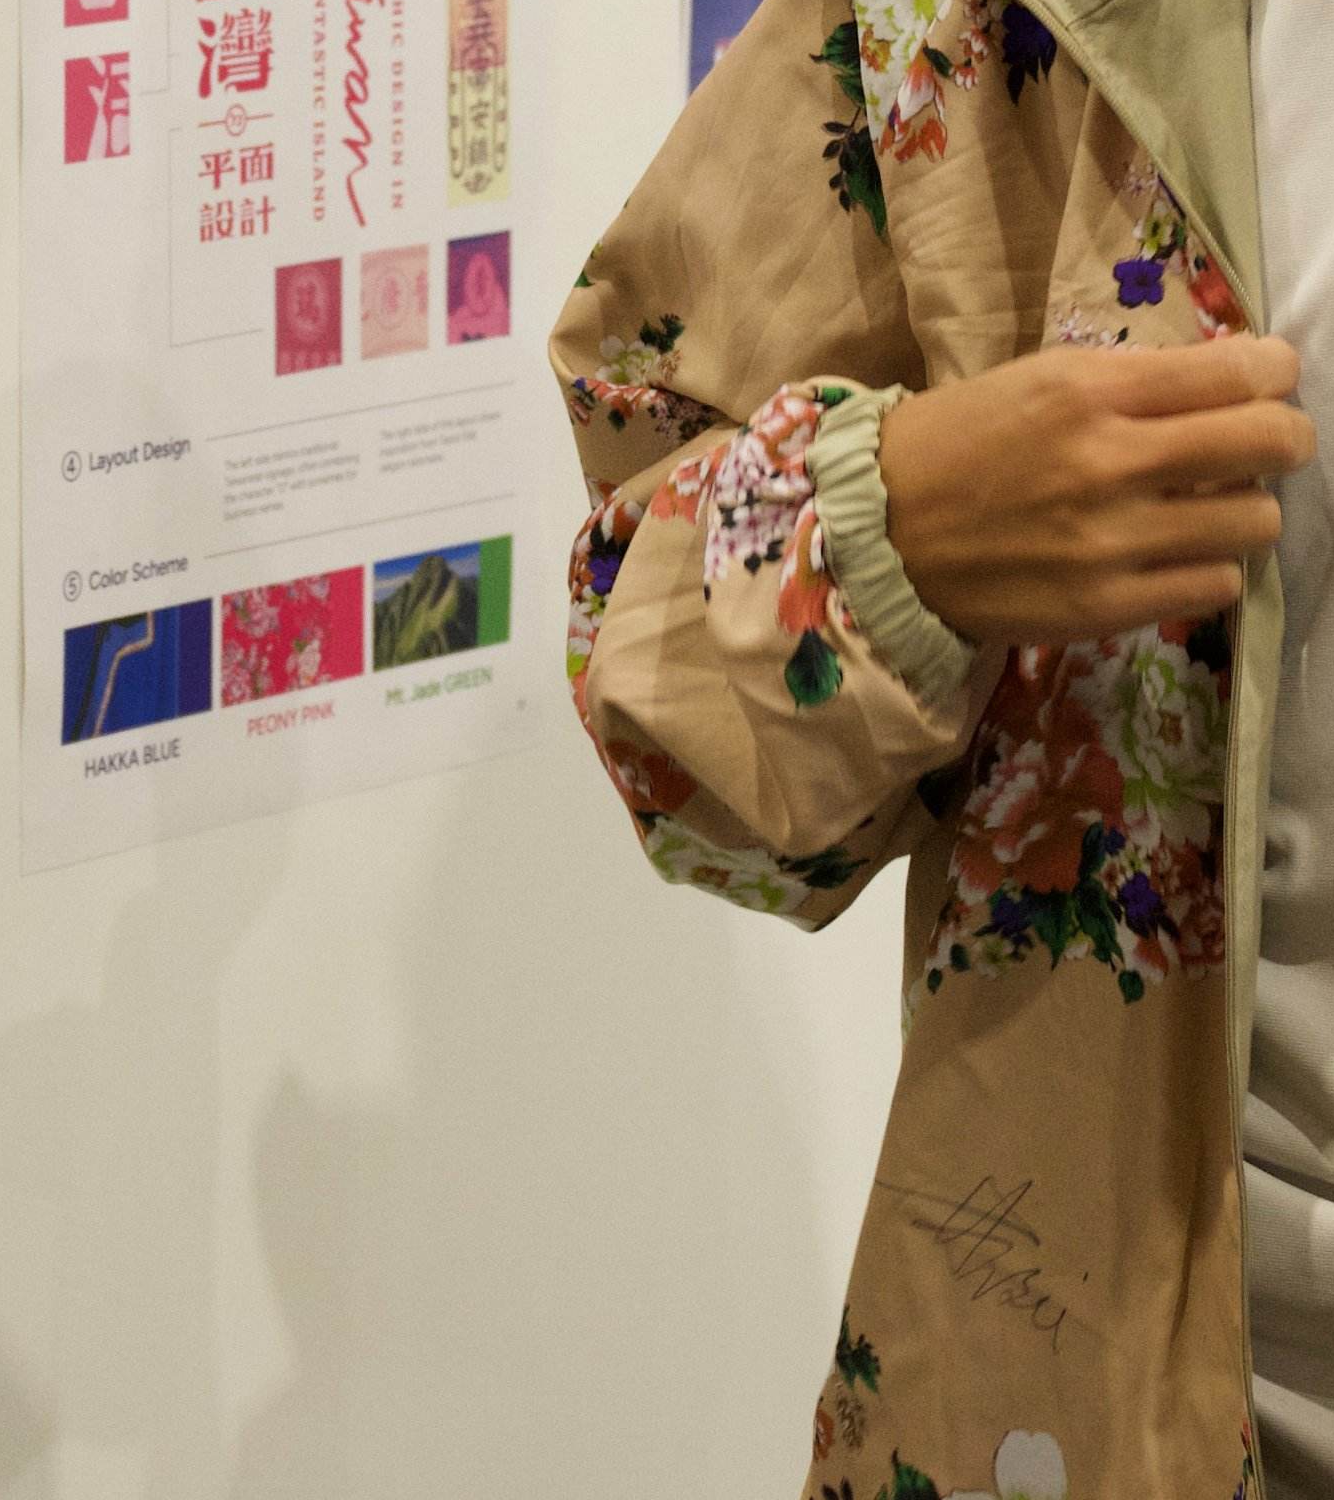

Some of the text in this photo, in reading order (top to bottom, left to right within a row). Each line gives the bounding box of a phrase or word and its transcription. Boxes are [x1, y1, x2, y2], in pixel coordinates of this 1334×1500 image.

[391, 61, 405, 166] DESIGN
[198, 142, 275, 190] 平面
[313, 120, 327, 223] ISLAND
[391, 180, 405, 210] IN
[199, 196, 276, 243] 設計
[90, 445, 139, 473] Layout
[143, 437, 191, 461] Design
[89, 568, 129, 591] Color
[132, 556, 190, 582] Scheme
[247, 701, 335, 737] PEONY PINK
[85, 737, 181, 777] HAKKA BLUE
